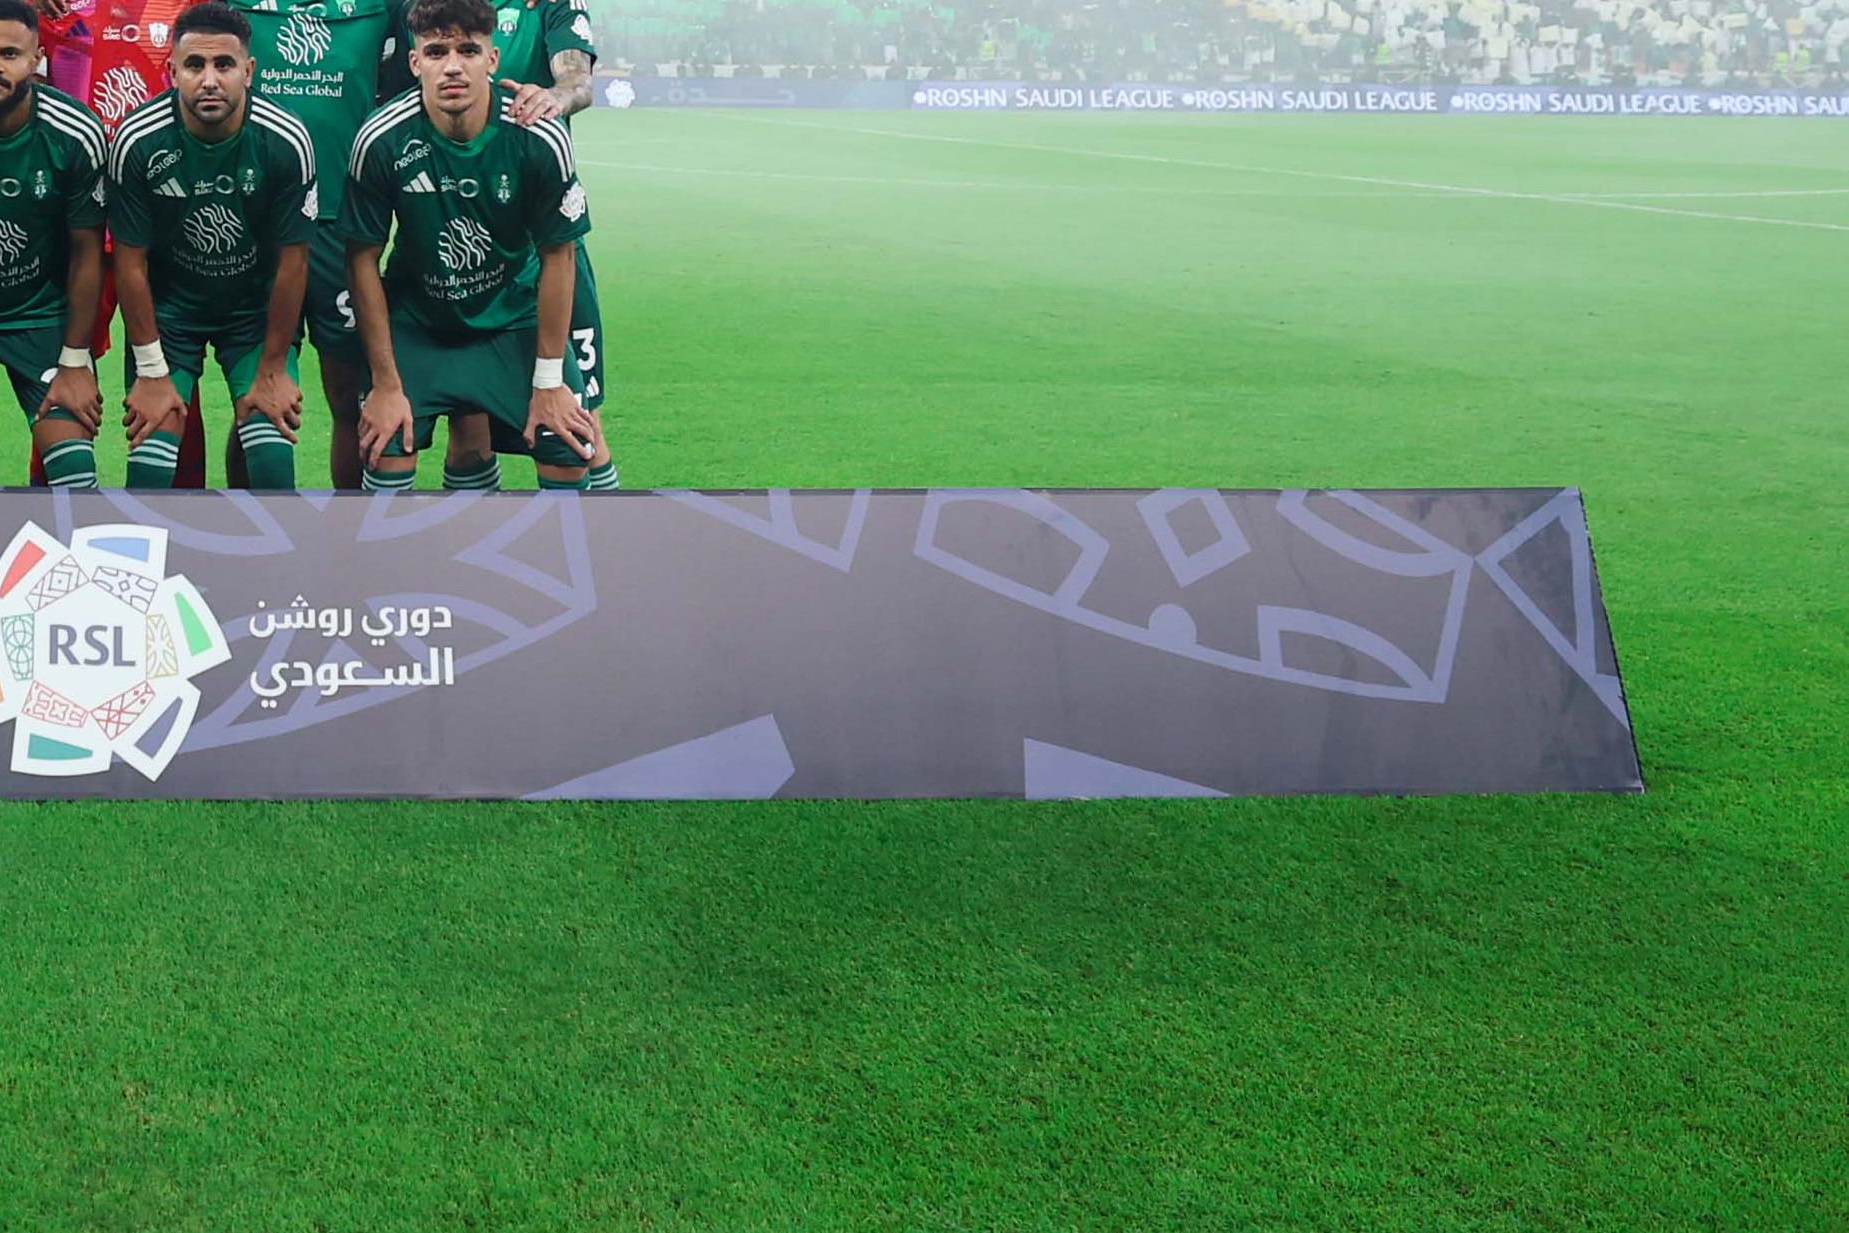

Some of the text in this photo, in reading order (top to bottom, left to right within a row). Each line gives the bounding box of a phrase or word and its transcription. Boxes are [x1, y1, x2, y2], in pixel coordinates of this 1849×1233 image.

[261, 83, 342, 98] Red Sea Global
[927, 88, 1174, 109] ROSHN SAUDI LEAGUE
[1195, 90, 1438, 110] ROSHN SAUDI LEAGUE
[1464, 92, 1702, 113] ROSHN SAUDI LEAGUE
[1721, 94, 1799, 114] ROSHN
[572, 328, 597, 371] 3
[250, 594, 452, 646] دوري روشن
[49, 624, 136, 666] RSL
[250, 647, 454, 708] السعودي
